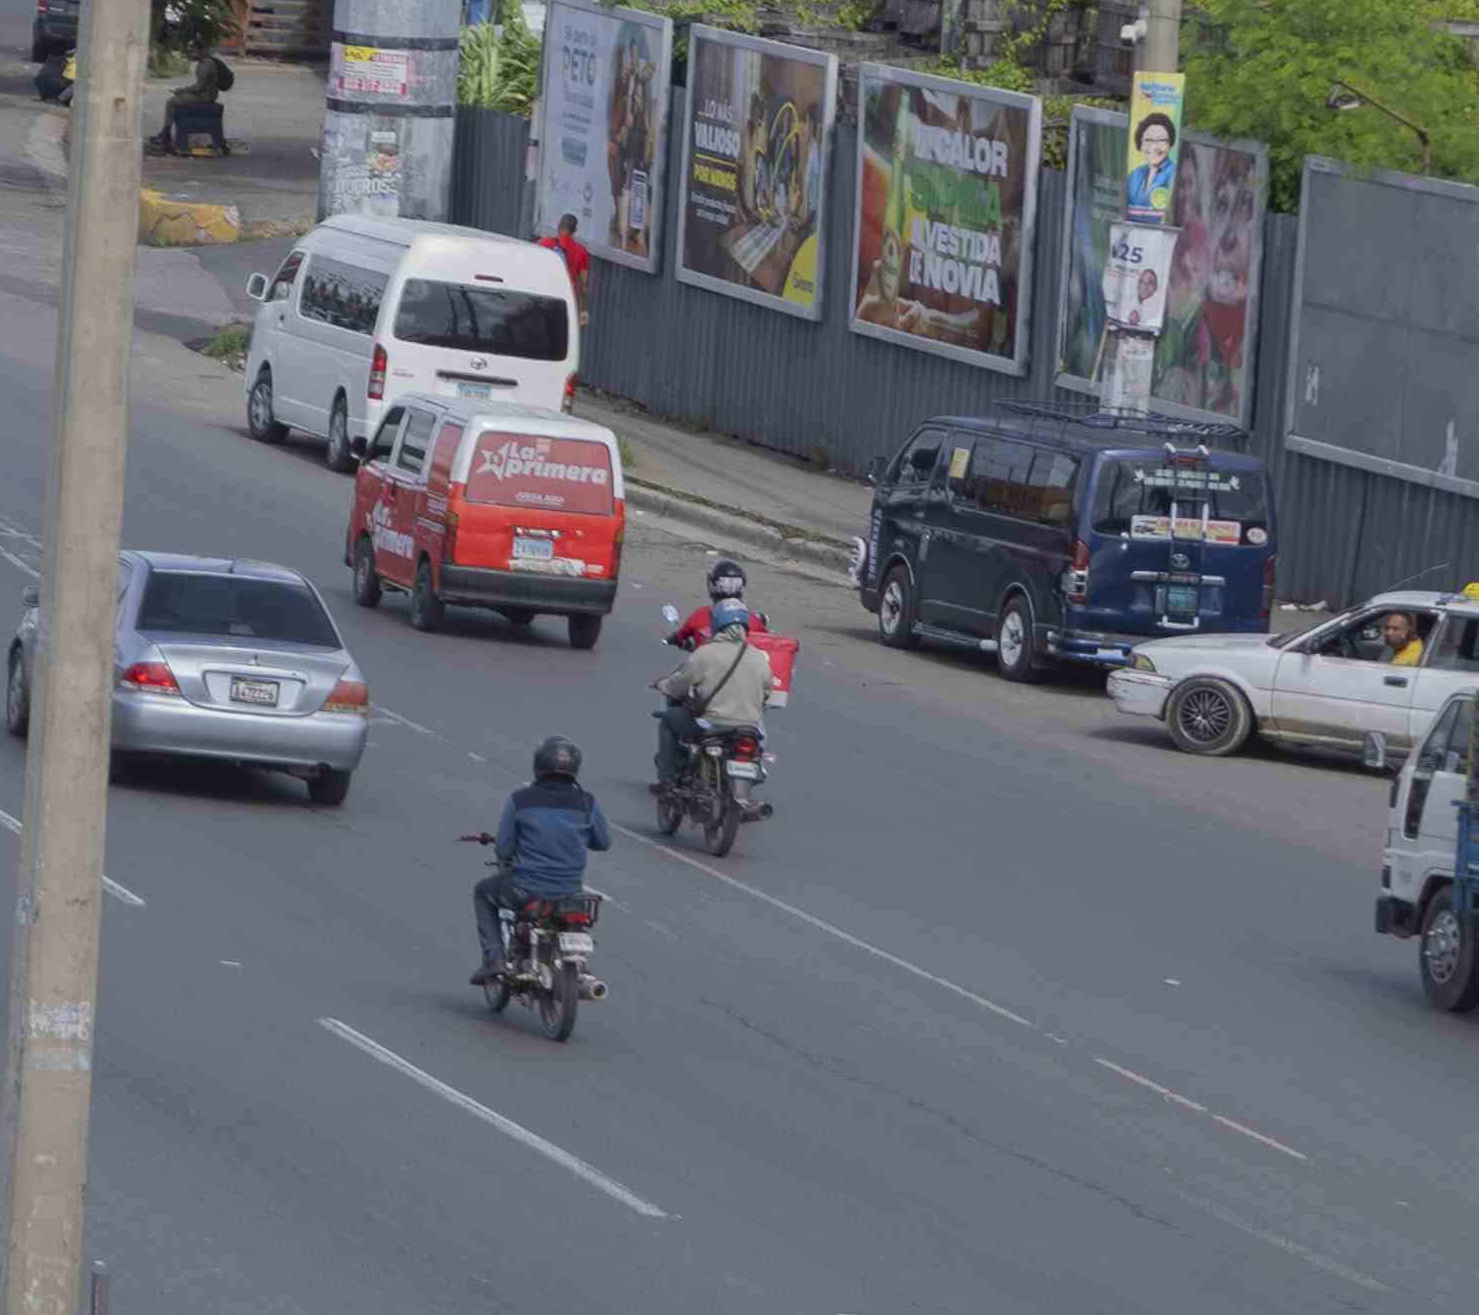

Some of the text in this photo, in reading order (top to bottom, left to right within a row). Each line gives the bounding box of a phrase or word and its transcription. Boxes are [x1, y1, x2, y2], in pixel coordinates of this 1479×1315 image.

[694, 121, 741, 159] VALIOSO
[923, 253, 1002, 306] NOVIA
[506, 442, 538, 459] La
[506, 458, 609, 486] primera
